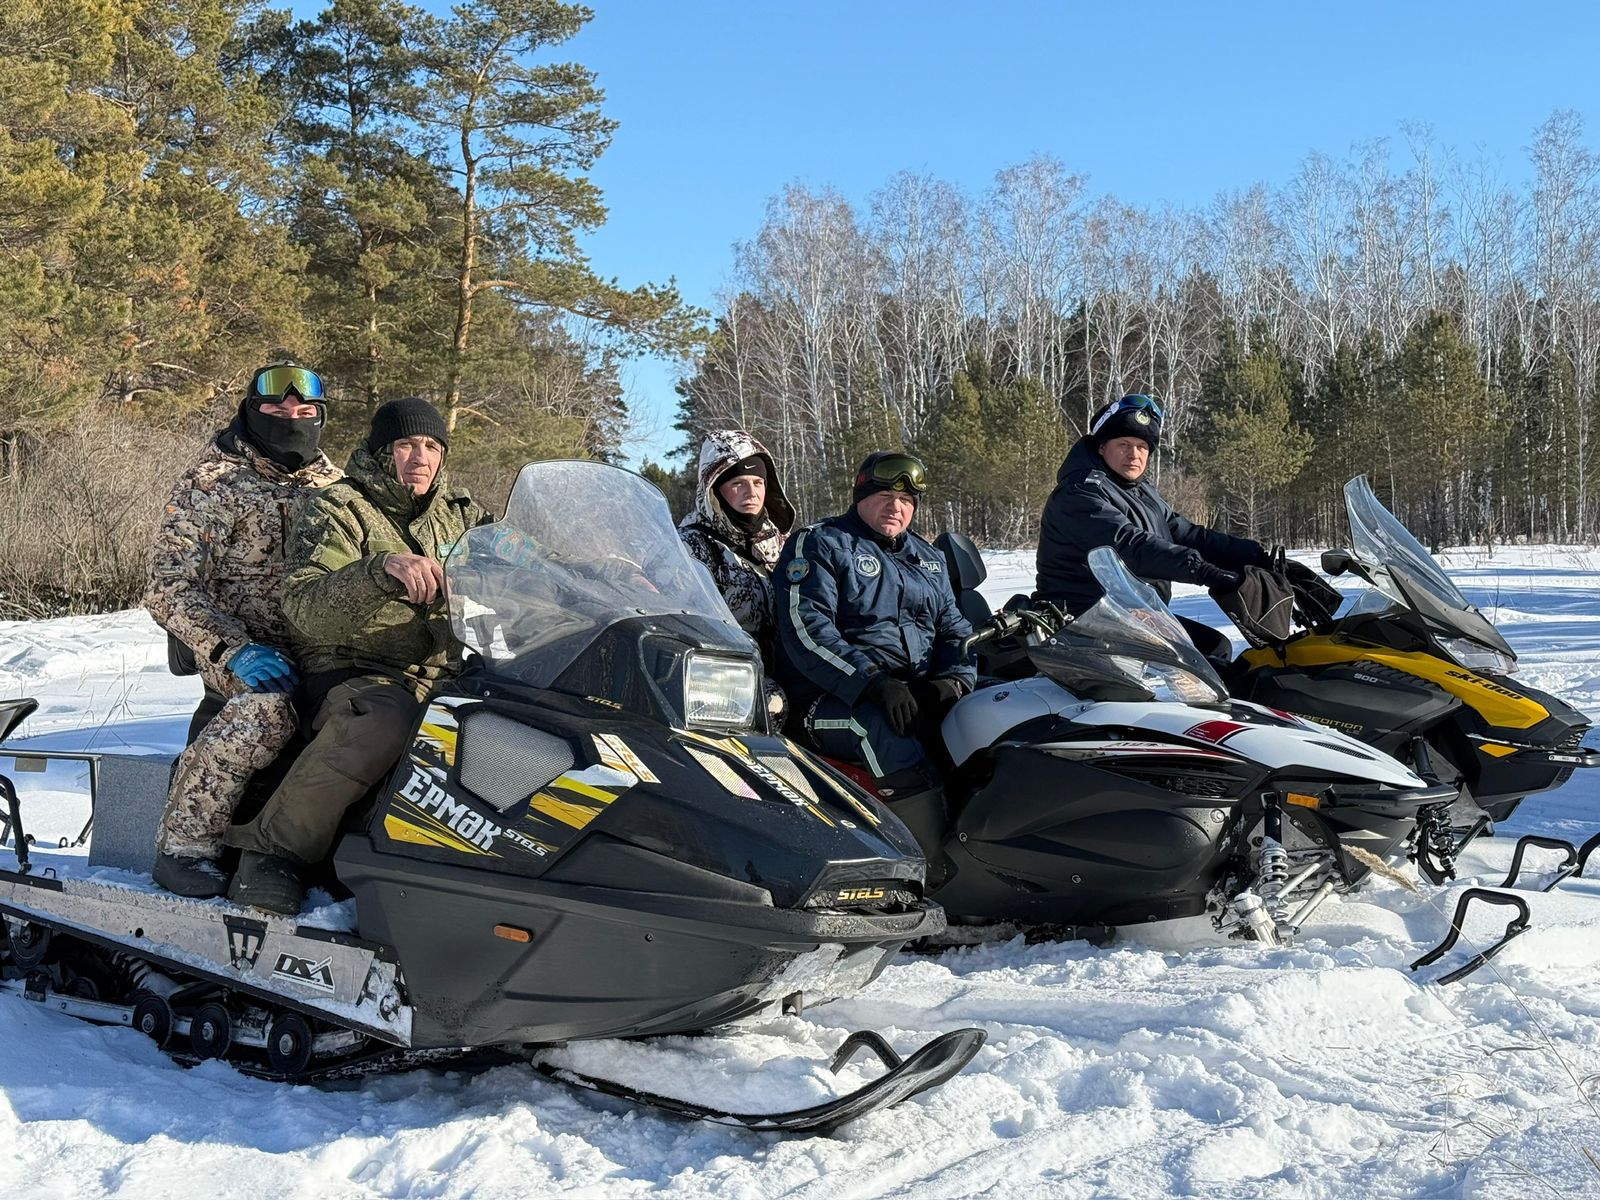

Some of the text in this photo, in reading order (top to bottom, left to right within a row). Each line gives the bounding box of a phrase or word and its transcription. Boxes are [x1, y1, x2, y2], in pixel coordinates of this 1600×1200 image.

[1353, 673, 1378, 683] 900
[503, 828, 549, 857] STELS
[837, 887, 884, 901] STELS
